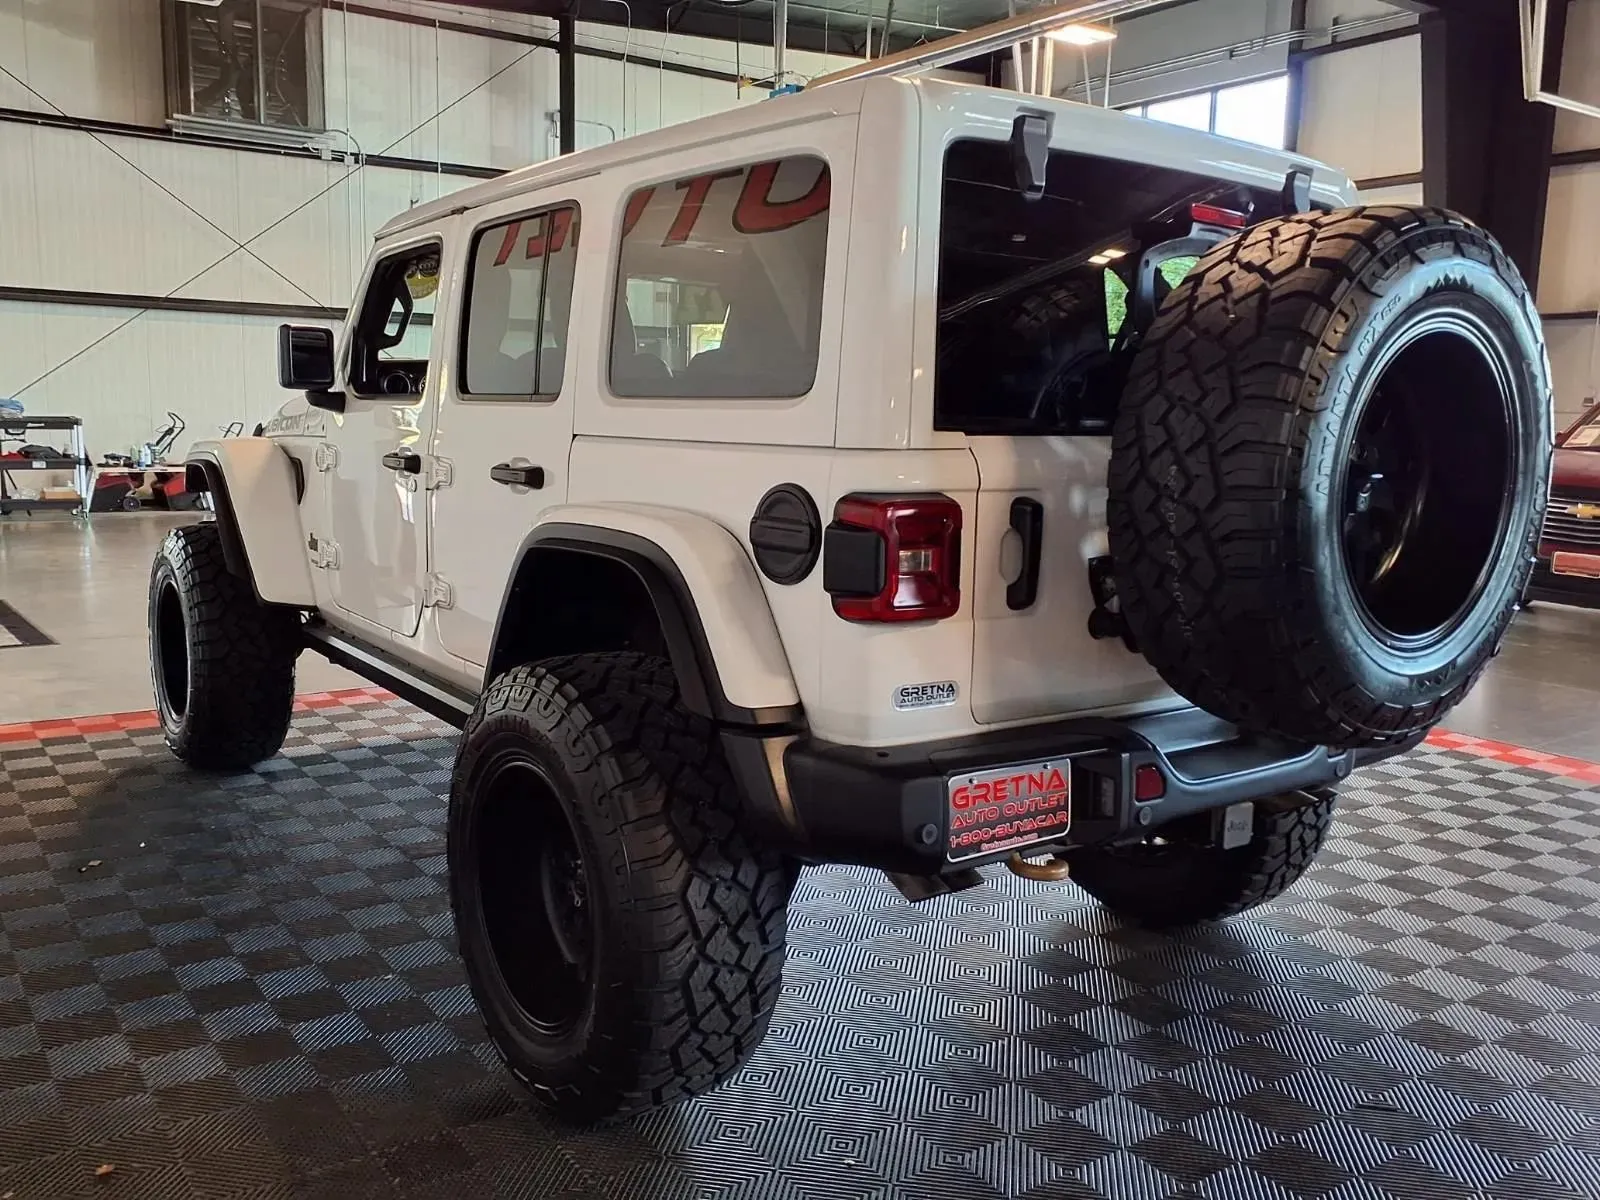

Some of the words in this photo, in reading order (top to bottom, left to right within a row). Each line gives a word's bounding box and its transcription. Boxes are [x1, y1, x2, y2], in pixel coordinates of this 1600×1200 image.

[900, 683, 955, 698] GRETNA
[900, 695, 924, 704] AUTO
[925, 692, 955, 701] OUTLET
[953, 768, 1067, 809] GRETNA
[950, 810, 1068, 848] 1-800-BUYACAR
[952, 806, 1000, 829] AUTO
[1004, 792, 1067, 815] OUTLET
